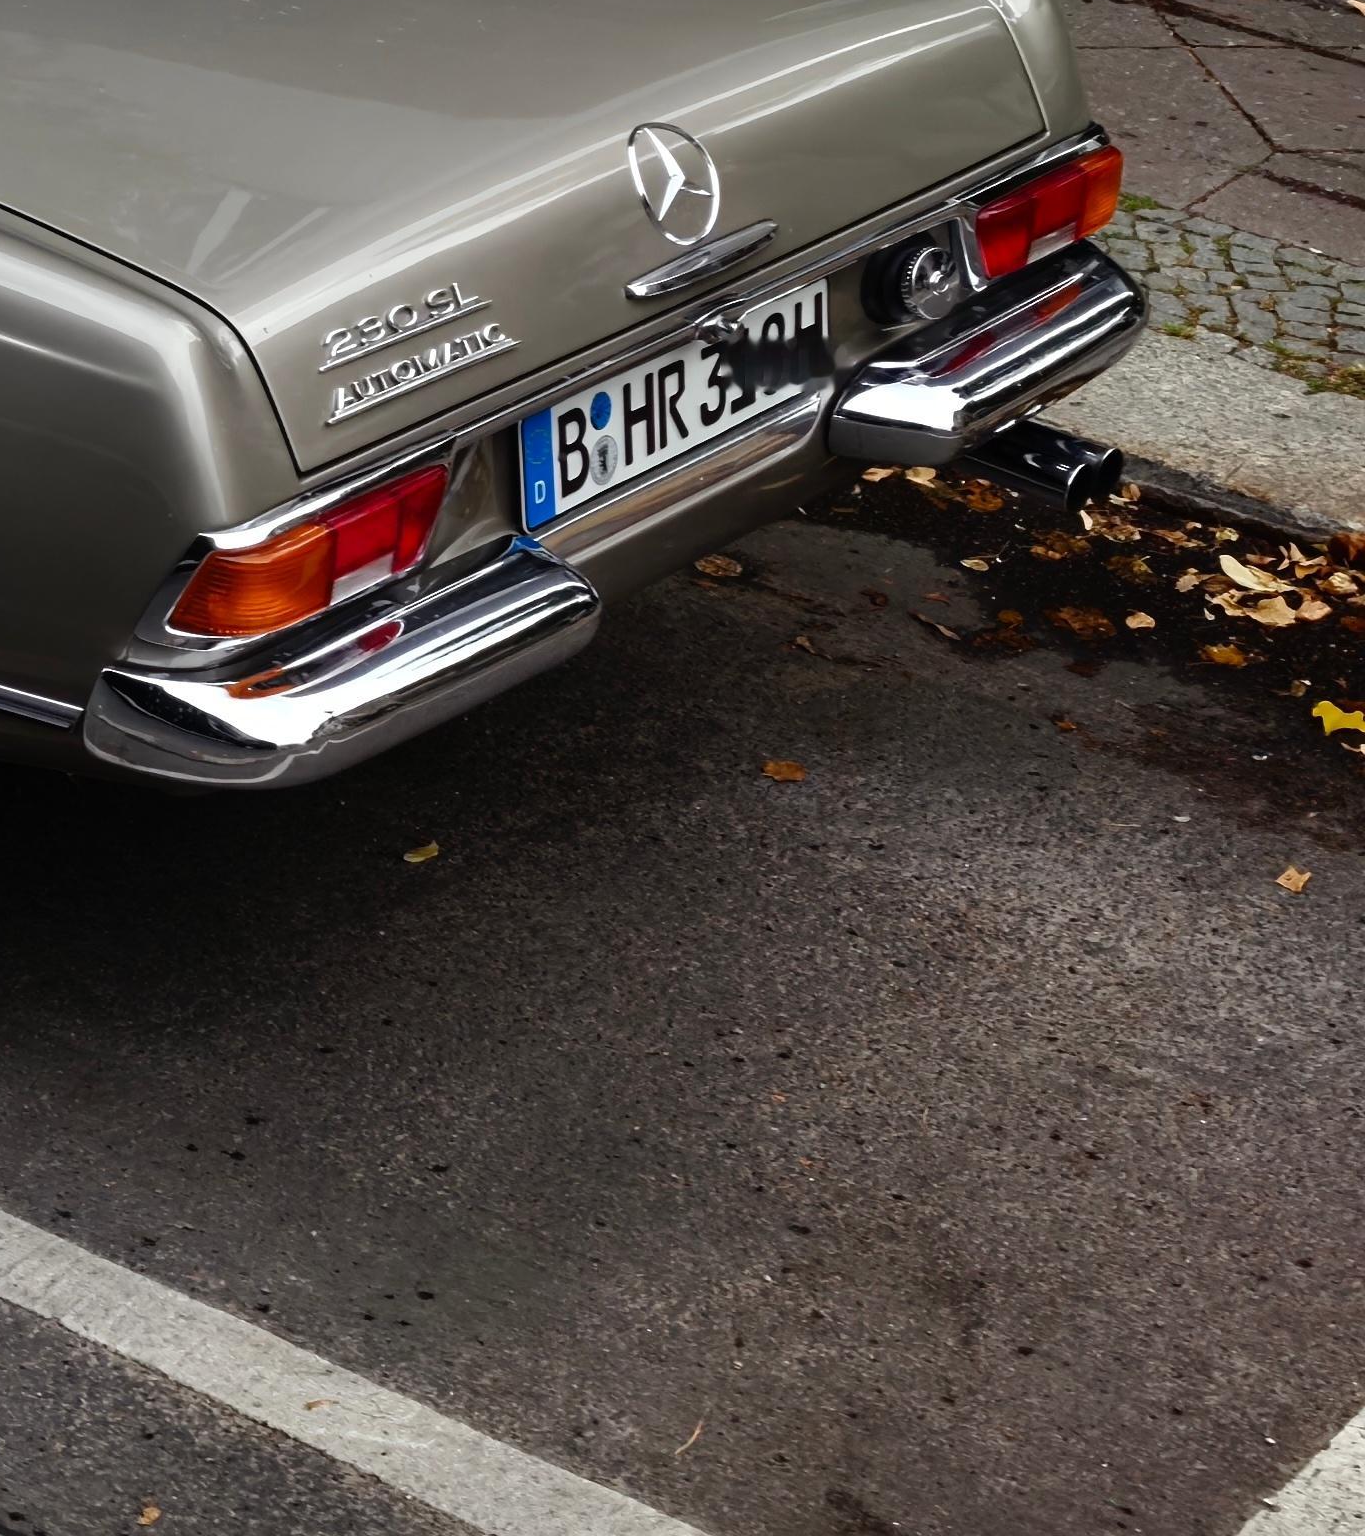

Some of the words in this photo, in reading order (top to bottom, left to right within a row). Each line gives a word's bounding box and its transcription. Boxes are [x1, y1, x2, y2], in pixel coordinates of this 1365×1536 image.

[426, 282, 479, 318] SL
[333, 323, 508, 412] AUTOMATIC
[558, 407, 590, 498] B
[623, 359, 689, 466] HR
[534, 480, 546, 505] D
